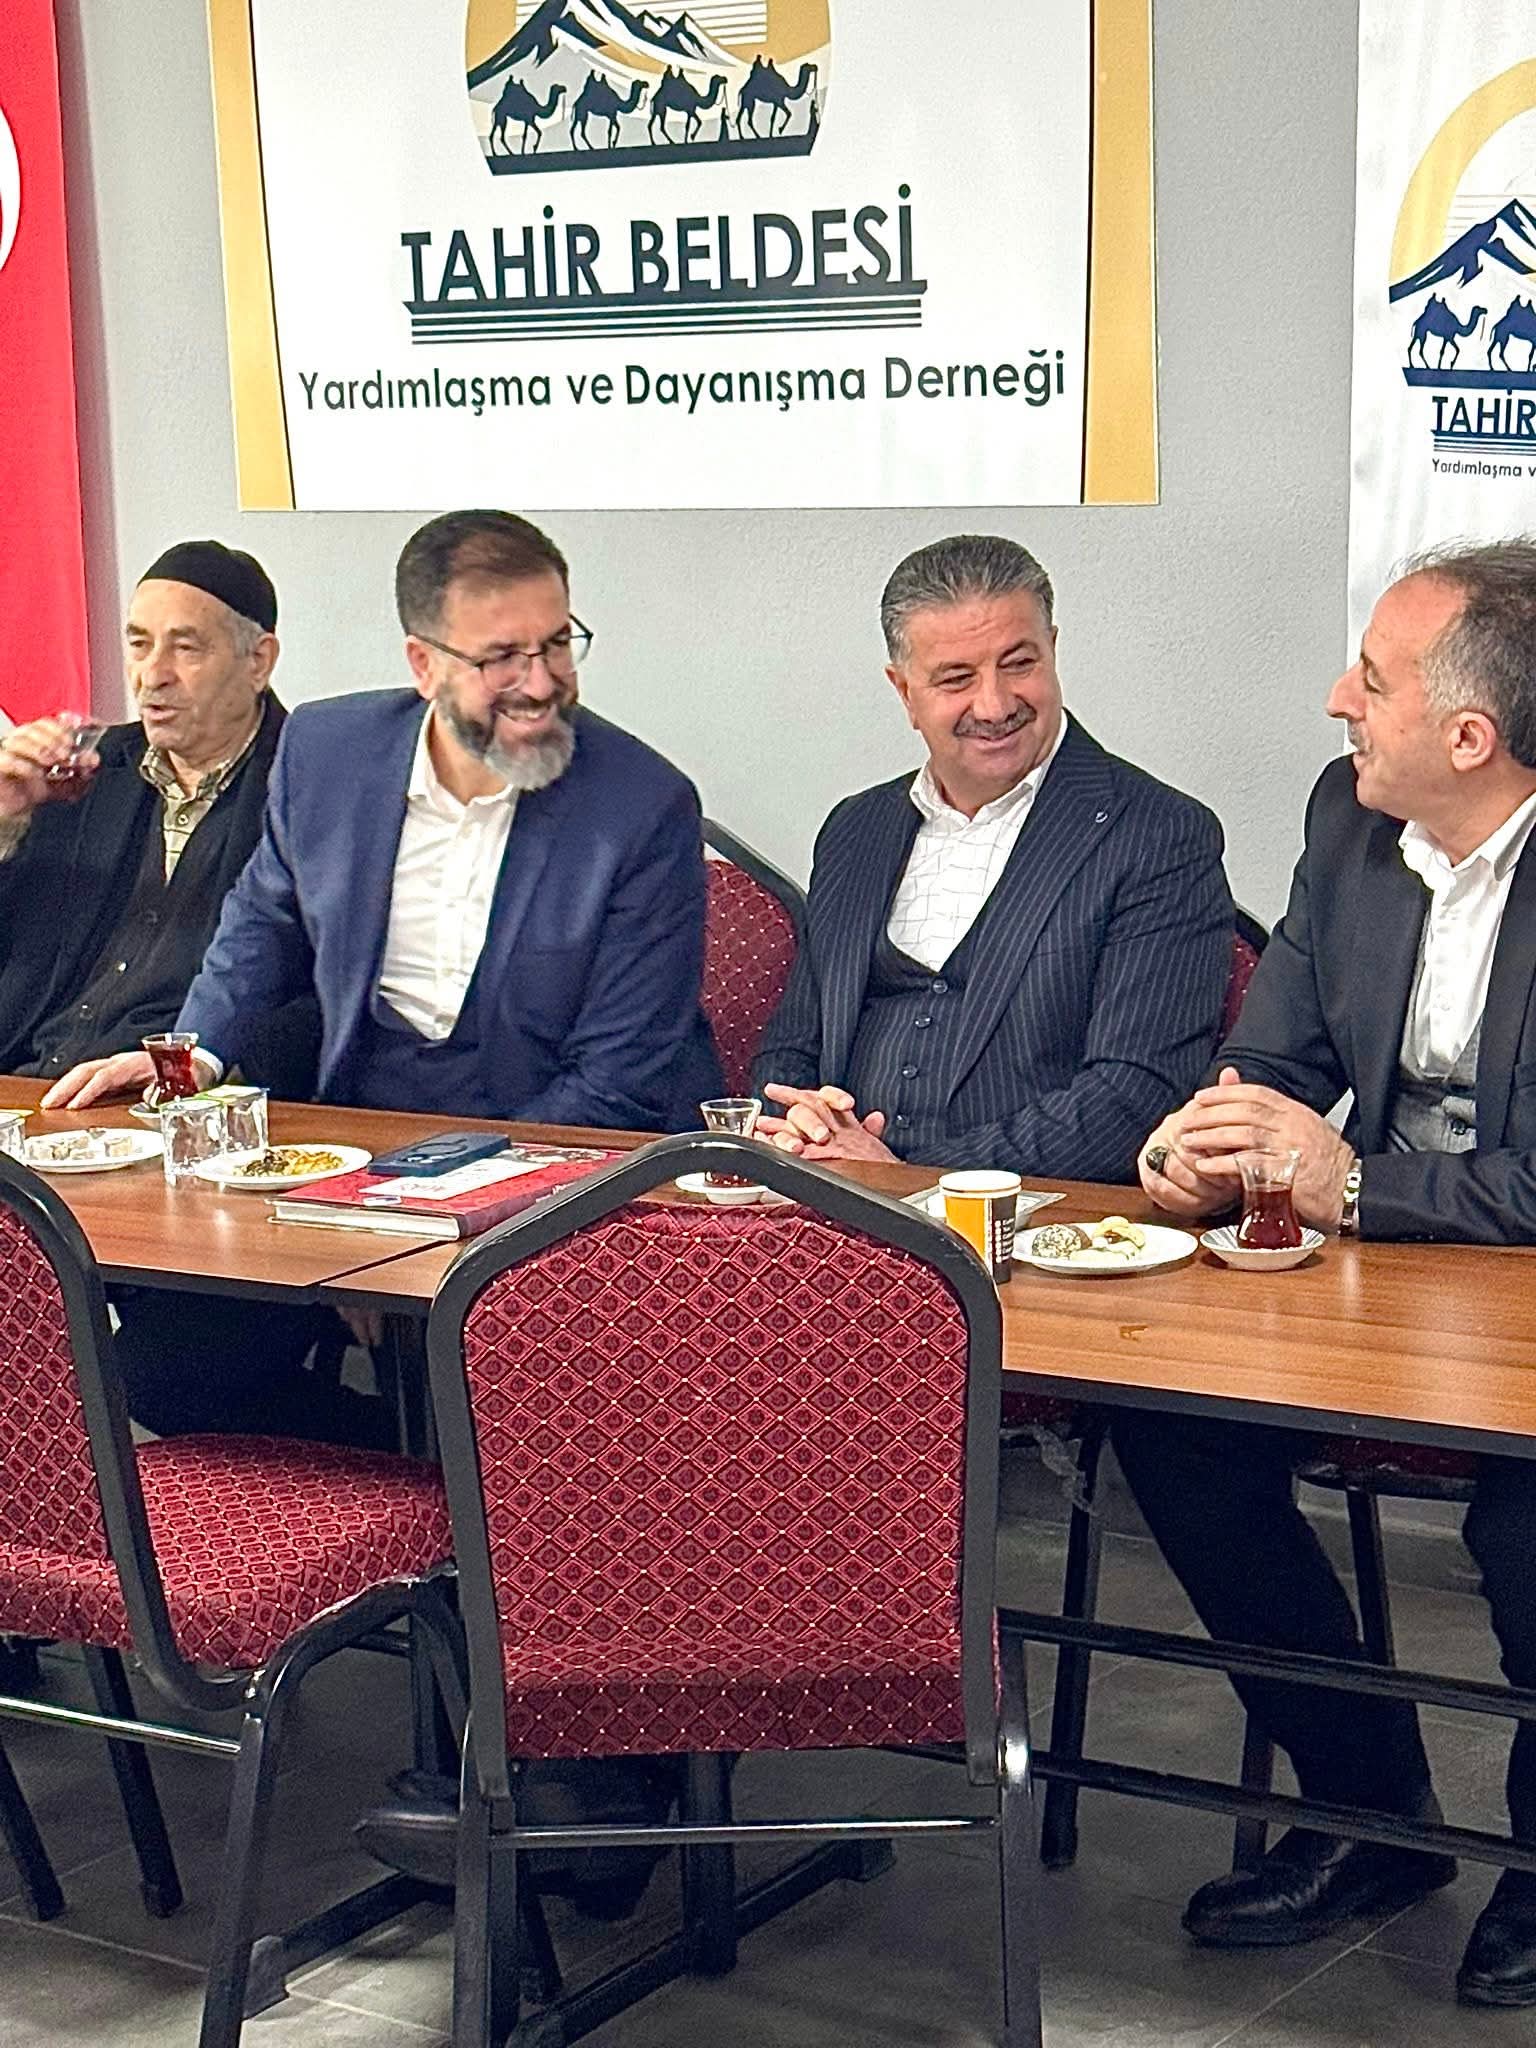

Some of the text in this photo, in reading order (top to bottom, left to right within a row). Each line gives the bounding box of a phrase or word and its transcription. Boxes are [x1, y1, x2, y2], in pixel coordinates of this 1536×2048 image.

[401, 184, 927, 304] TAHİR BELDESİ
[298, 348, 1065, 417] Yardımlaşma ve Dayanışma Derneği
[1432, 389, 1536, 437] TAHİR
[1432, 458, 1522, 479] Yardımlaşma
